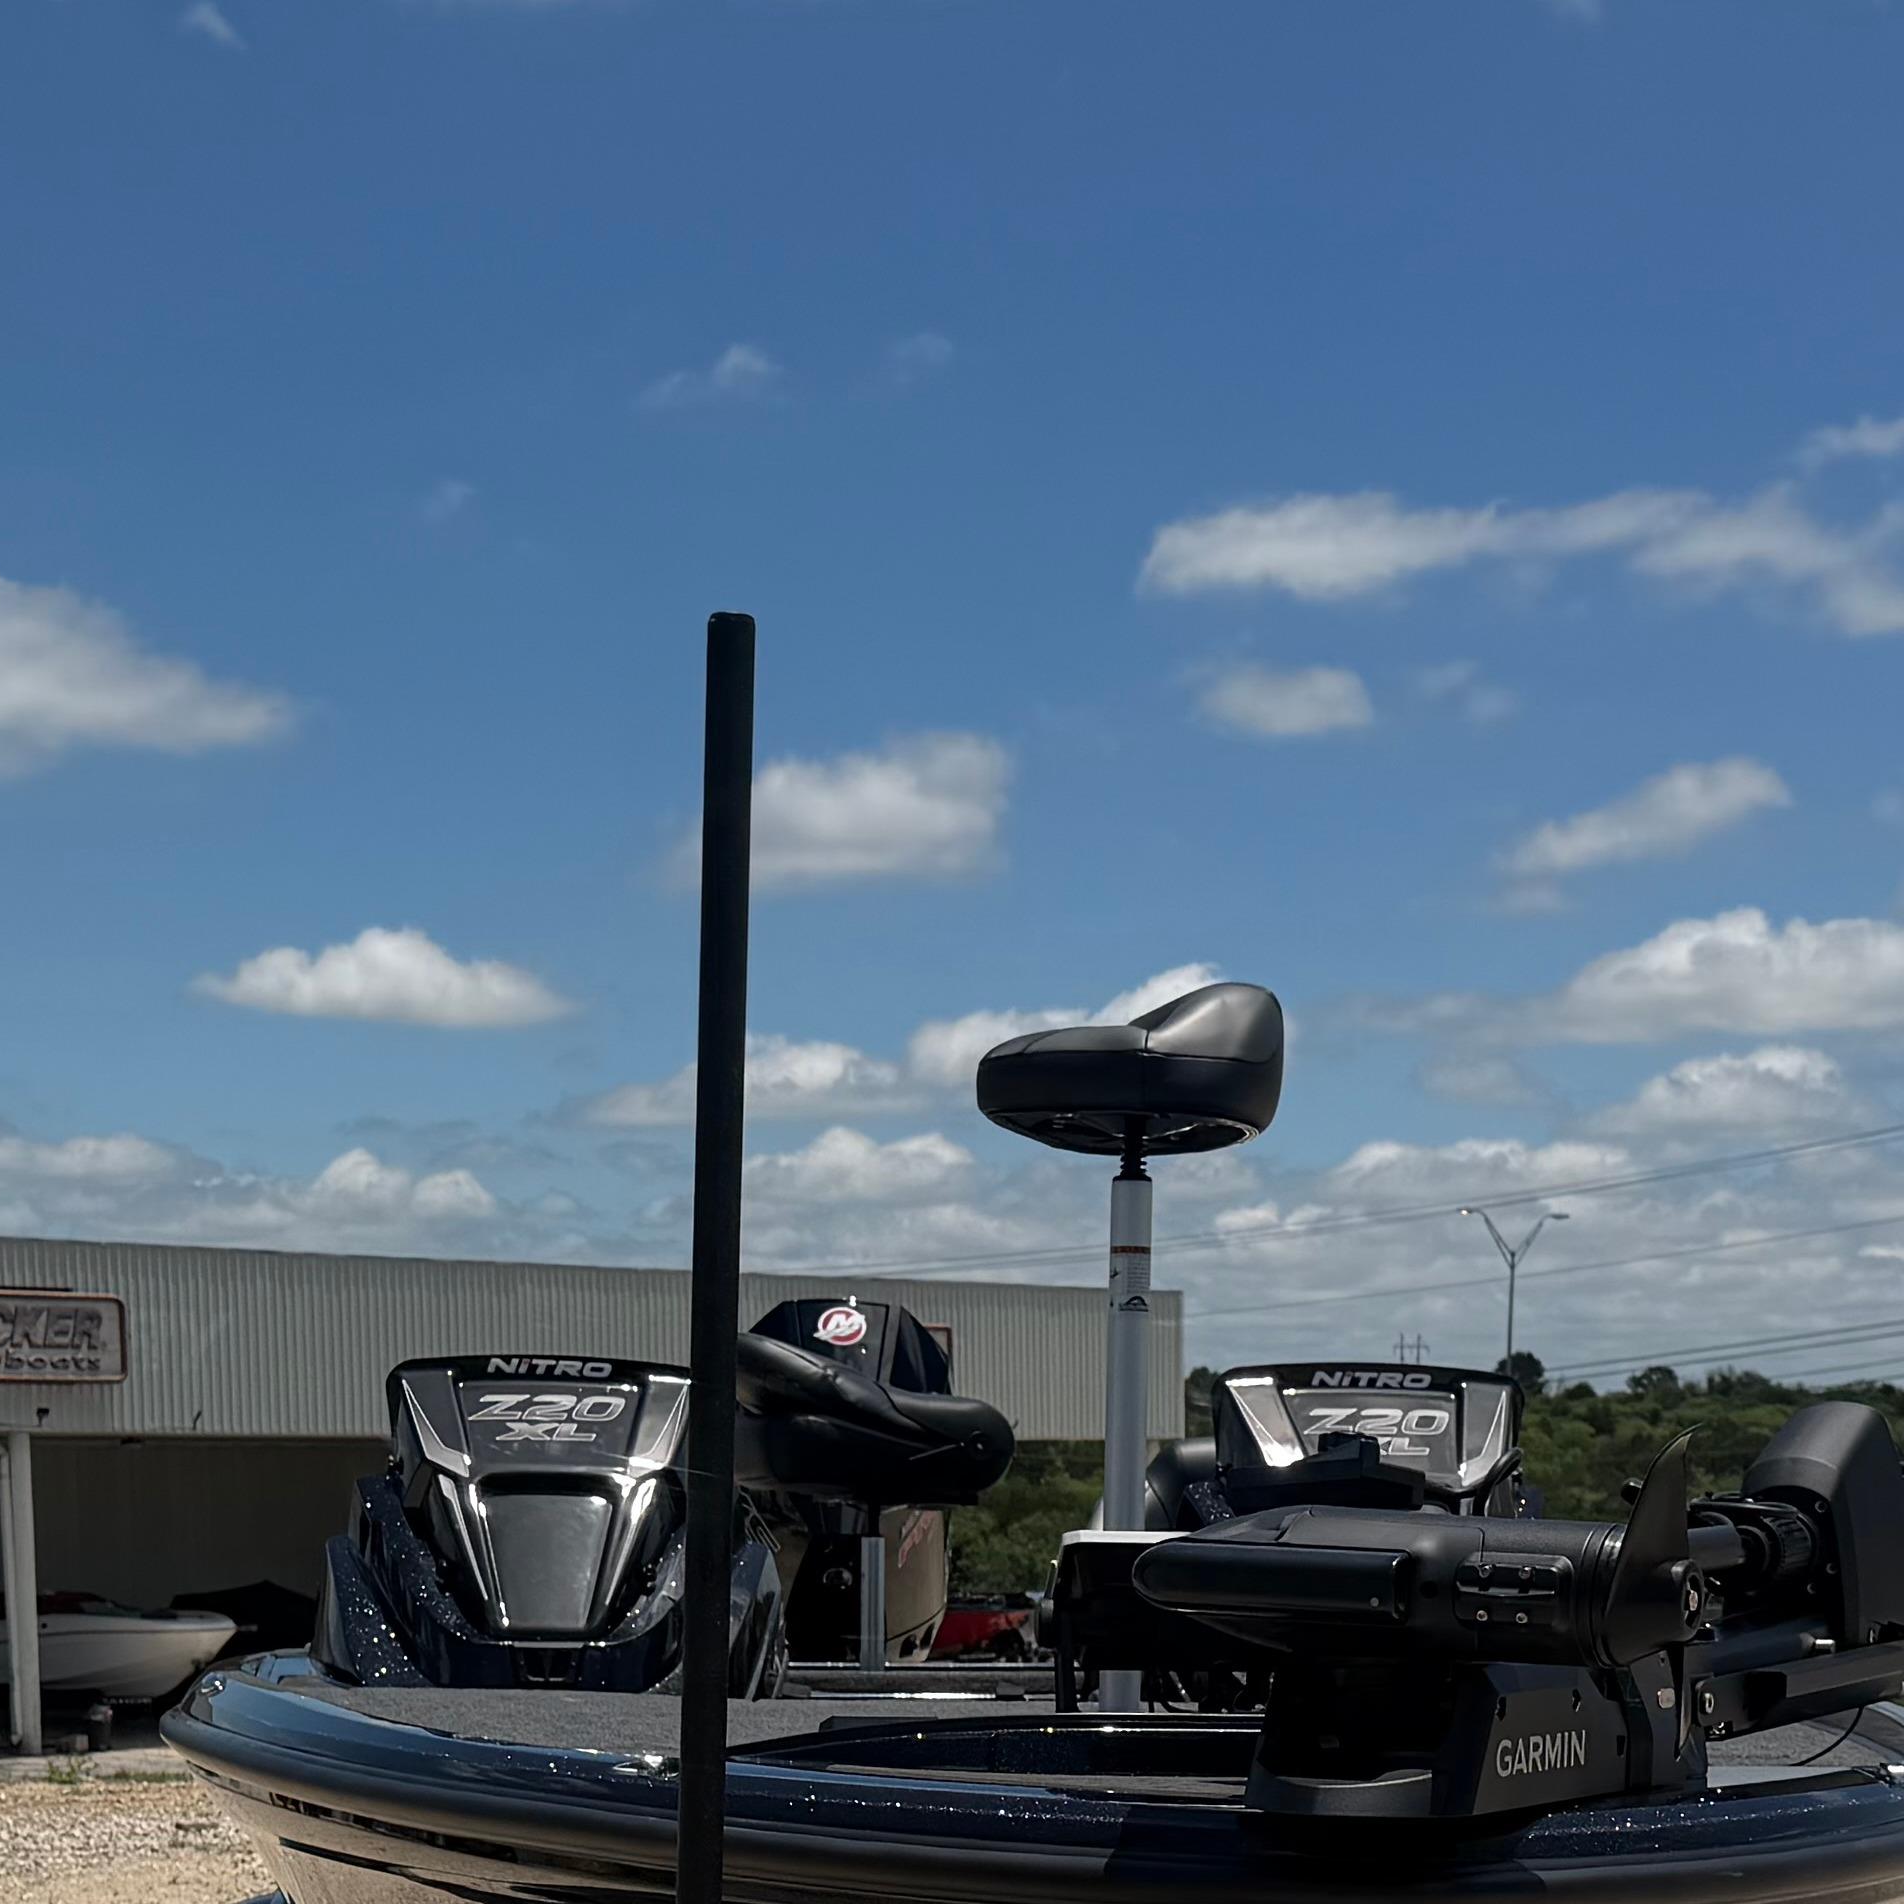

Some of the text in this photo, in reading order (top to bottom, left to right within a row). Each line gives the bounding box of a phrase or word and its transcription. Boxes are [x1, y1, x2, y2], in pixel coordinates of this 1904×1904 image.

[4, 1347, 101, 1371] boats
[468, 1394, 626, 1422] Z20
[1304, 1407, 1450, 1436] Z20
[496, 1422, 596, 1442] XL
[1496, 1729, 1586, 1777] GARMIN
